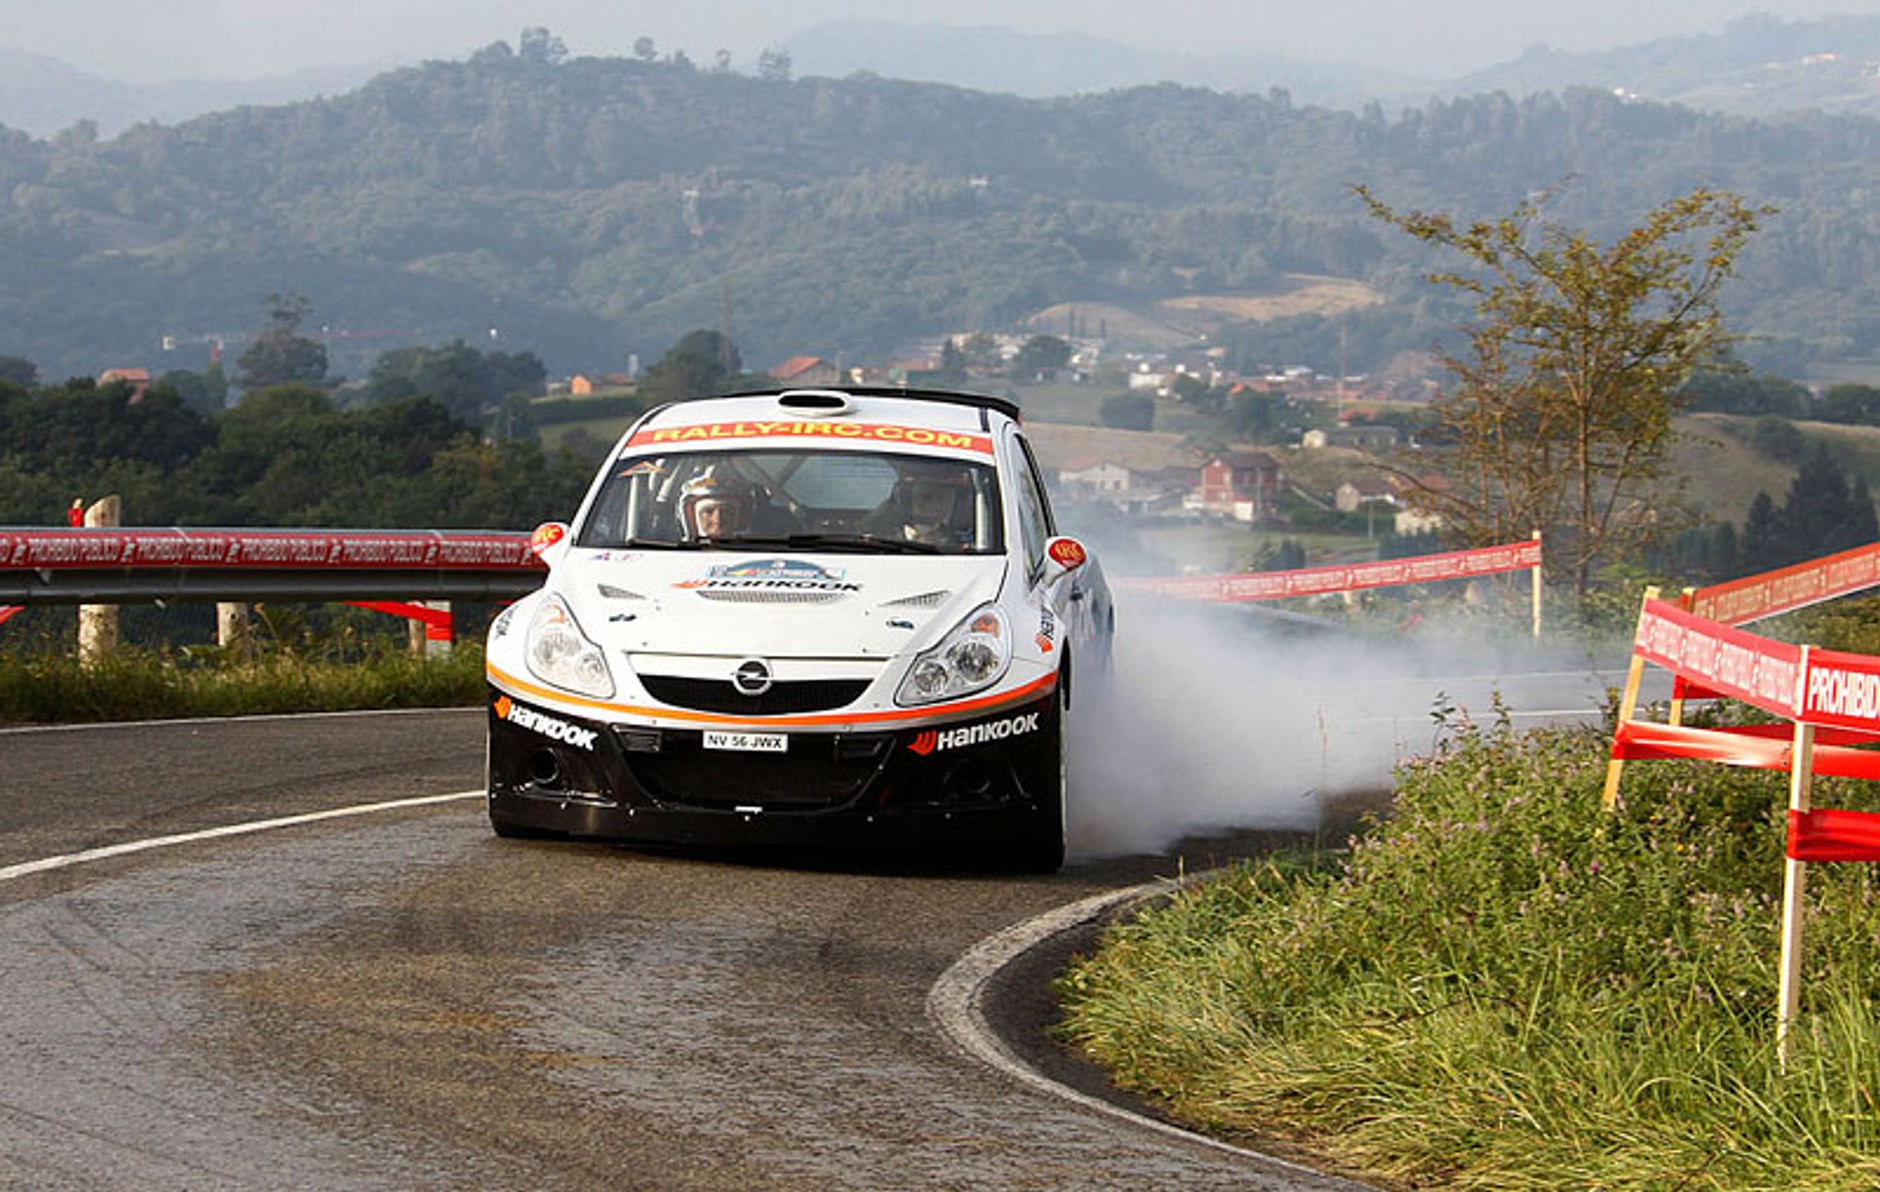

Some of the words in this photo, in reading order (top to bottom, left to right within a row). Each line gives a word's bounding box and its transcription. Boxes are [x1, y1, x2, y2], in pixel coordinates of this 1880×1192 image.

[652, 421, 973, 448] RALLY-IRC.COM
[1807, 667, 1880, 719] PROHIBID
[707, 733, 728, 746] NV
[731, 735, 749, 747] 56
[750, 735, 782, 748] JWX
